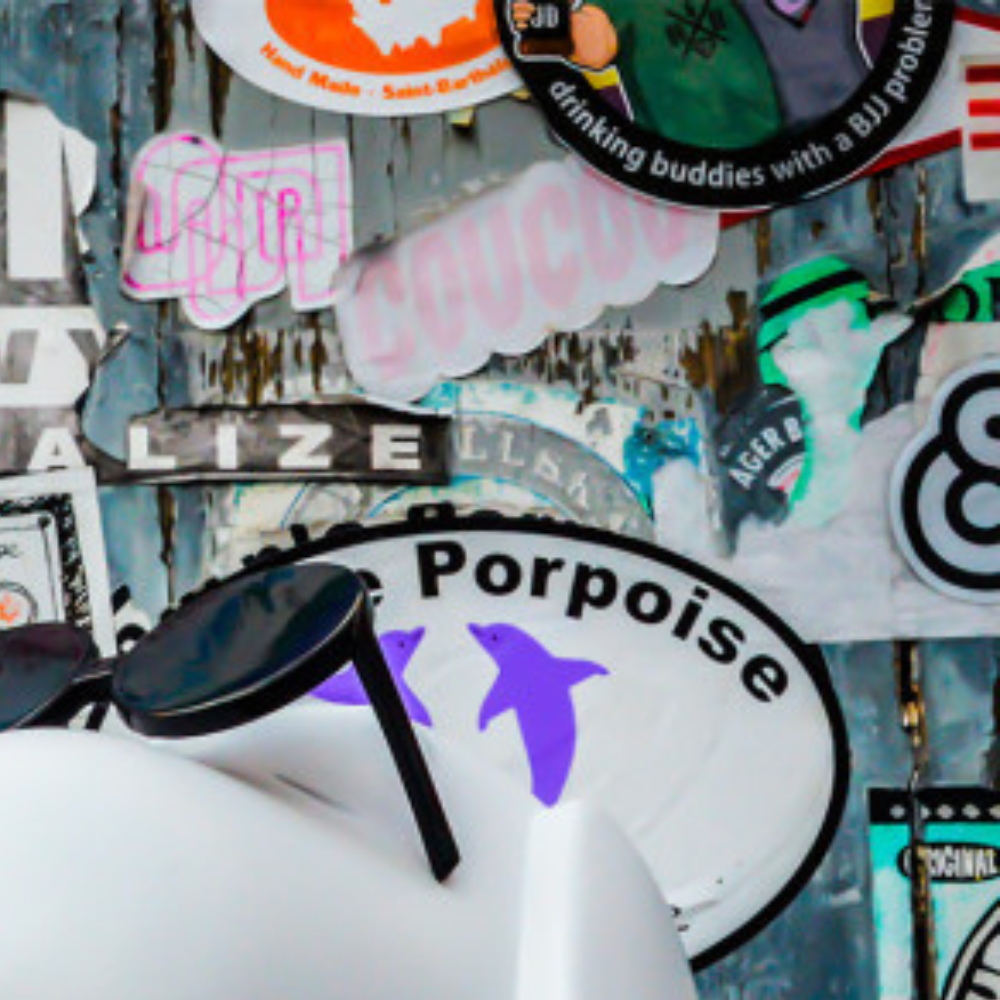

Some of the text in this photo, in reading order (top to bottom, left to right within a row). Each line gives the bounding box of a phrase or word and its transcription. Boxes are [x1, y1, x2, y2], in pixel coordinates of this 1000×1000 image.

[308, 69, 361, 98] Made
[550, 80, 646, 172] drinking
[650, 150, 766, 188] buddies
[769, 142, 834, 182] with
[834, 132, 853, 152] a
[847, 95, 890, 138] BJJ
[415, 540, 790, 703] Porpoise
